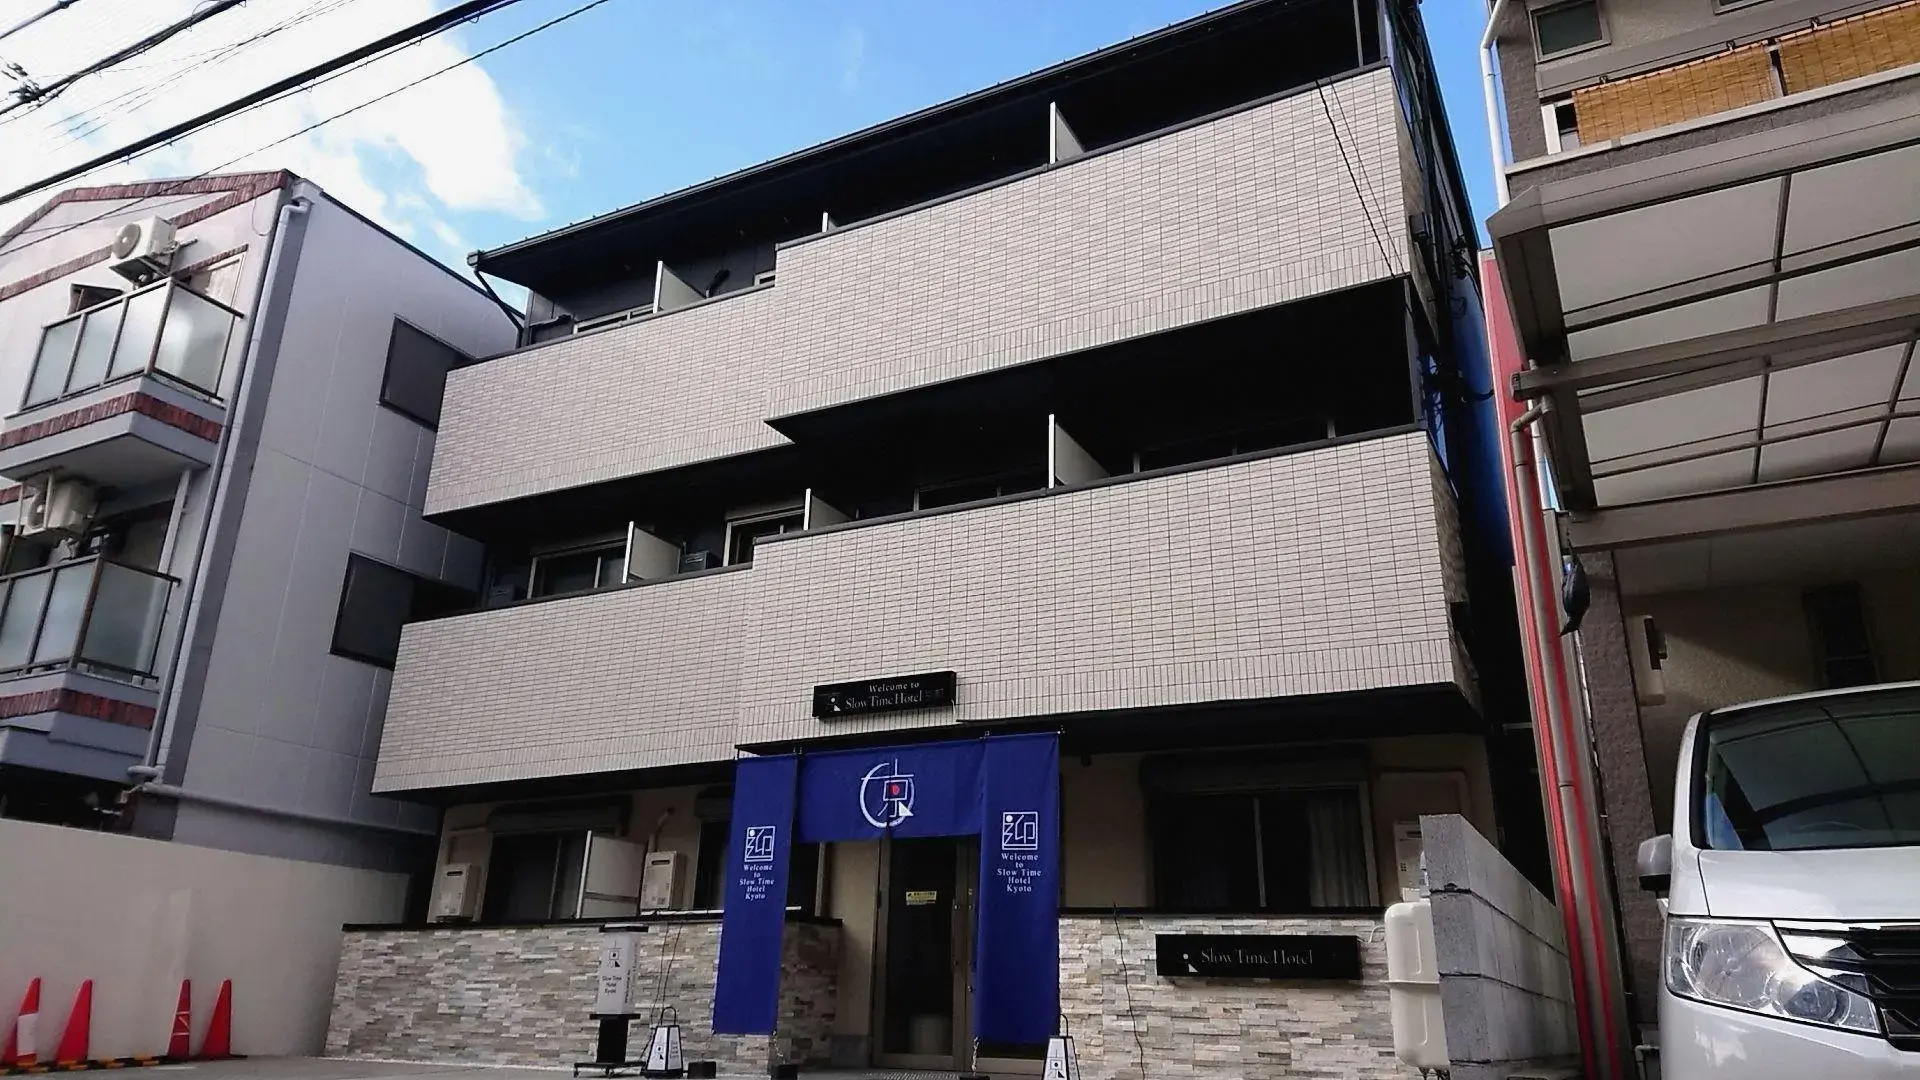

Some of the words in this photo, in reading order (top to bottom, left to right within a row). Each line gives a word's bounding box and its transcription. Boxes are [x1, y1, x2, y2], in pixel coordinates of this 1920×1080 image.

[869, 681, 908, 693] Welcome
[910, 681, 920, 689] to
[845, 697, 867, 710] Slow
[868, 695, 892, 707] Time
[894, 690, 922, 705] Hotel
[1001, 852, 1039, 861] Welcome
[997, 868, 1017, 876] Slow
[1021, 868, 1042, 877] Time
[740, 878, 755, 886] Slow
[758, 877, 775, 886] Time
[1008, 876, 1031, 884] Hotel
[747, 885, 766, 893] Hotel
[1006, 884, 1032, 893] Kyoto
[745, 892, 766, 901] Kyoto
[1201, 947, 1232, 964] Slow
[1233, 948, 1269, 964] Time
[1273, 948, 1313, 965] Hotel
